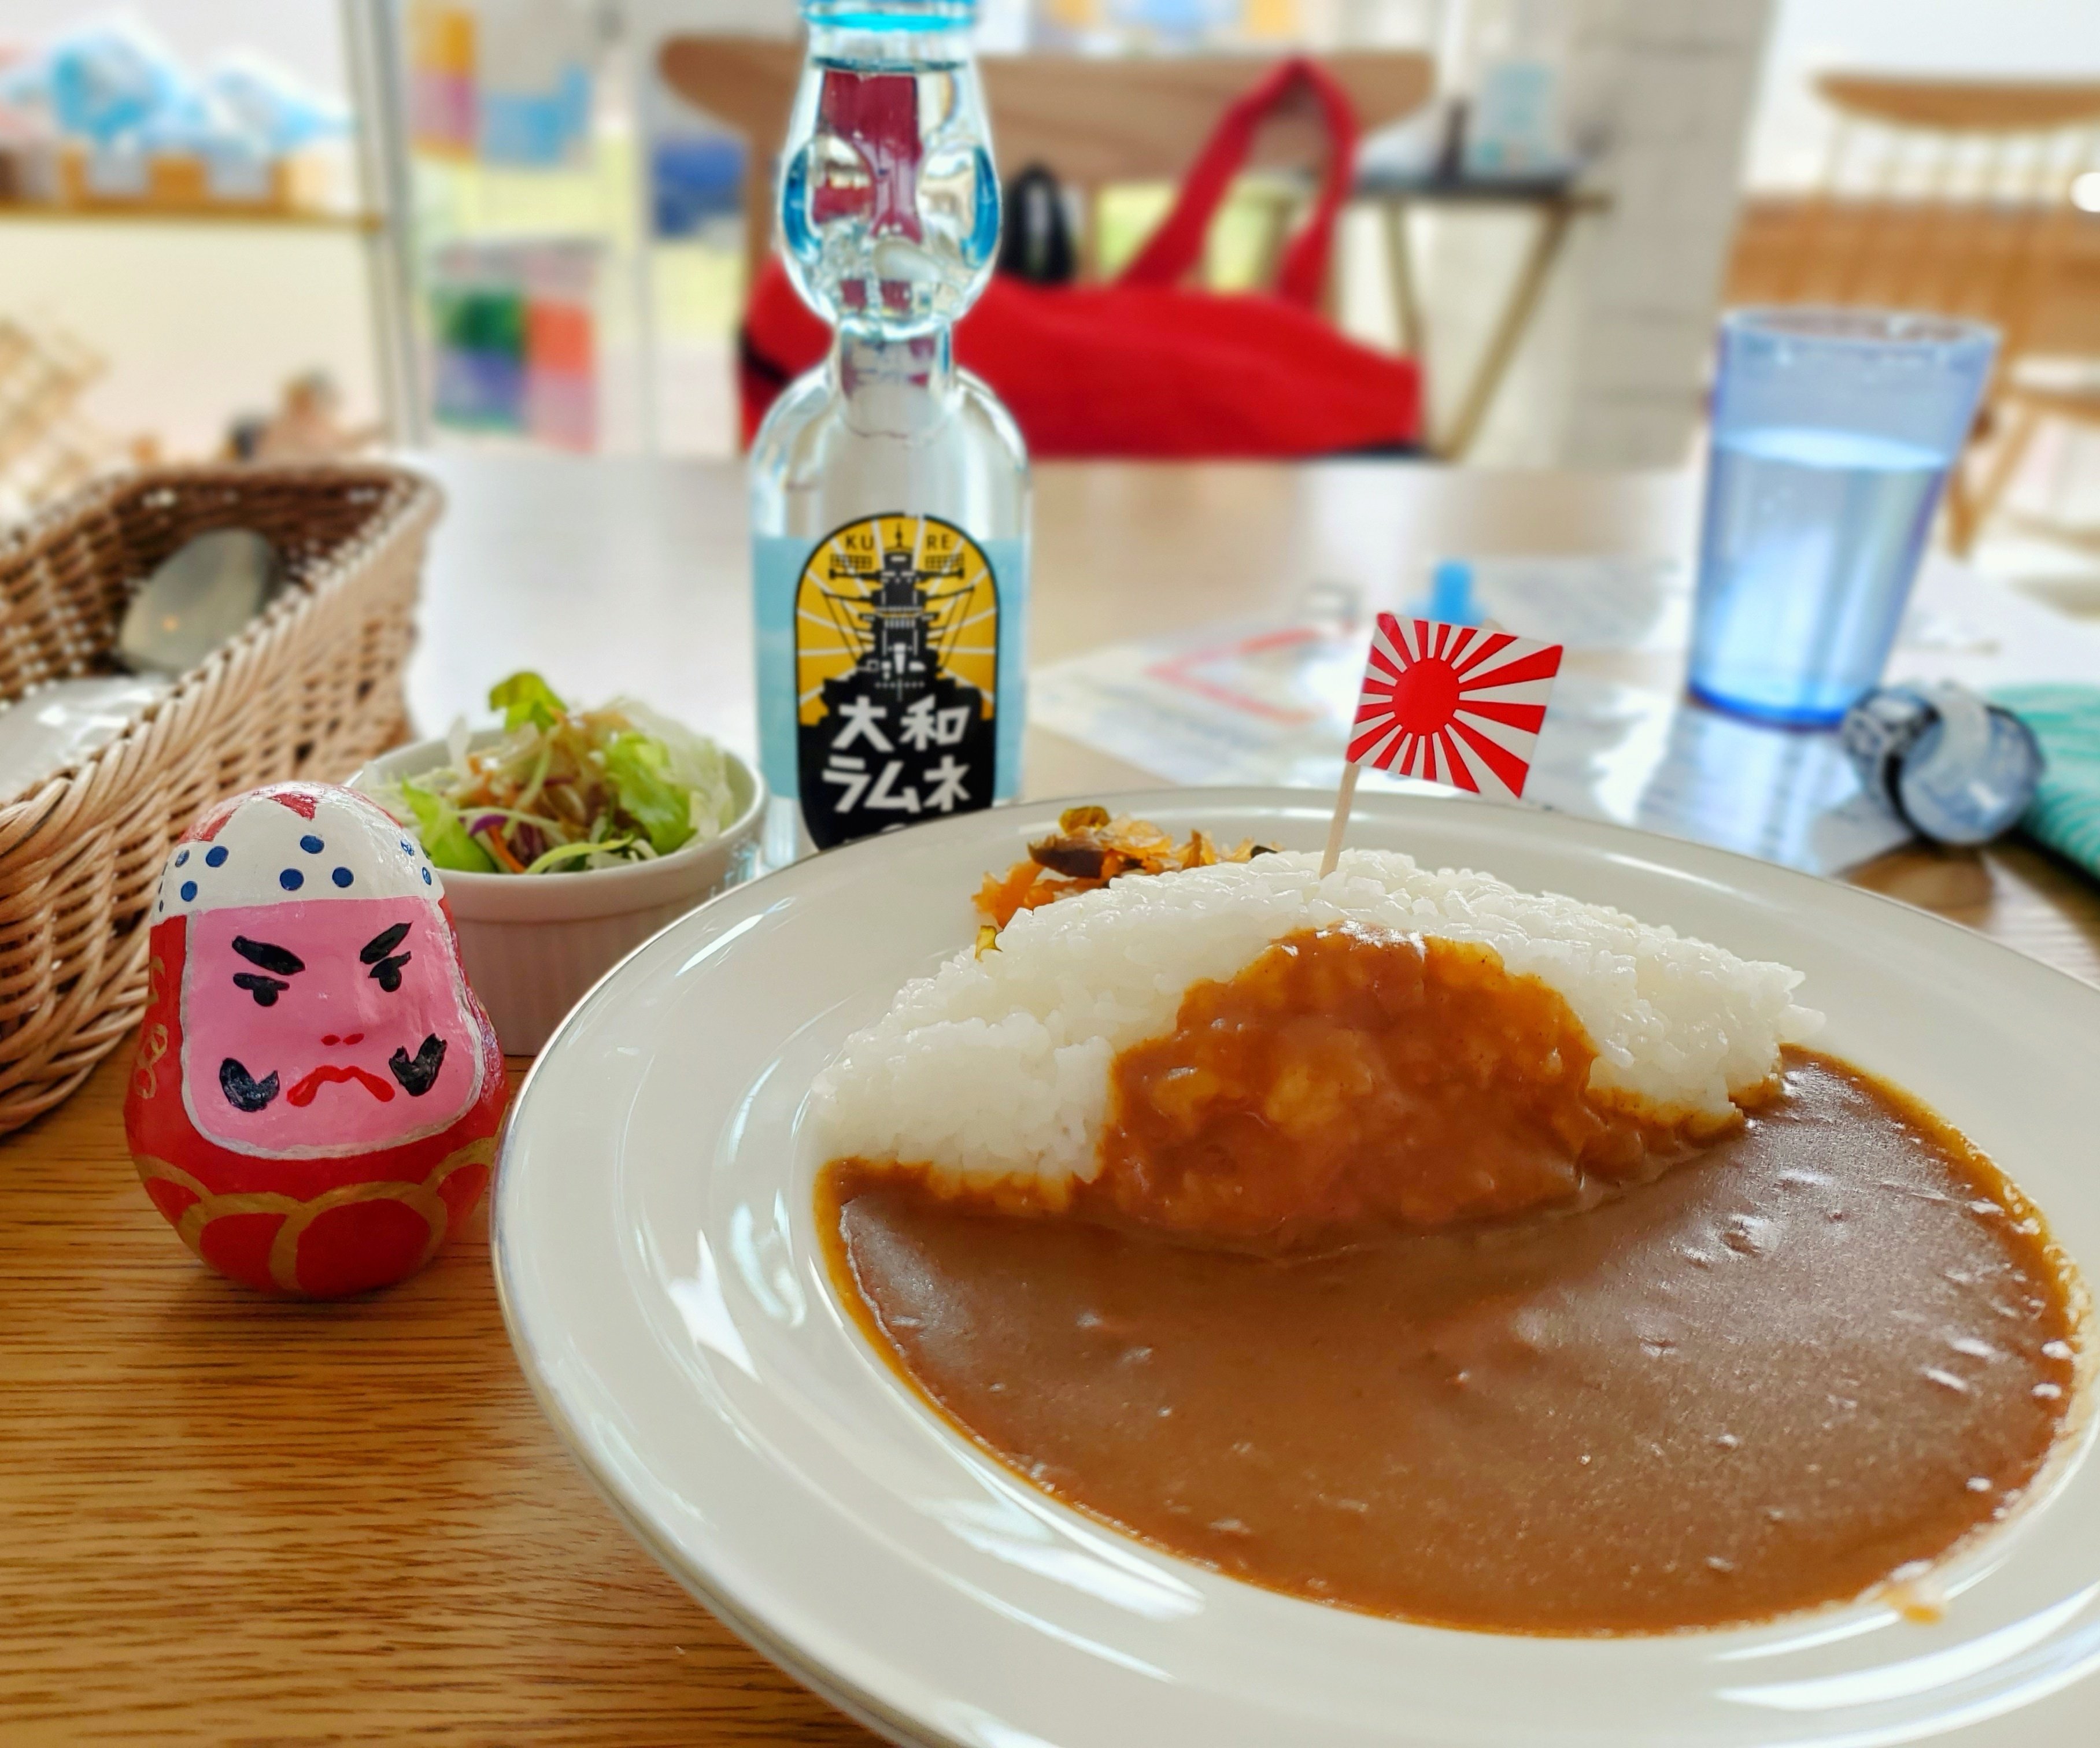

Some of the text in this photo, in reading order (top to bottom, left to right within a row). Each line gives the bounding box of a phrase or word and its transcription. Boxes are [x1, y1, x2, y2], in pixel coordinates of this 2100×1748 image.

[831, 694, 971, 752] 大和
[822, 754, 971, 813] ラムネ
